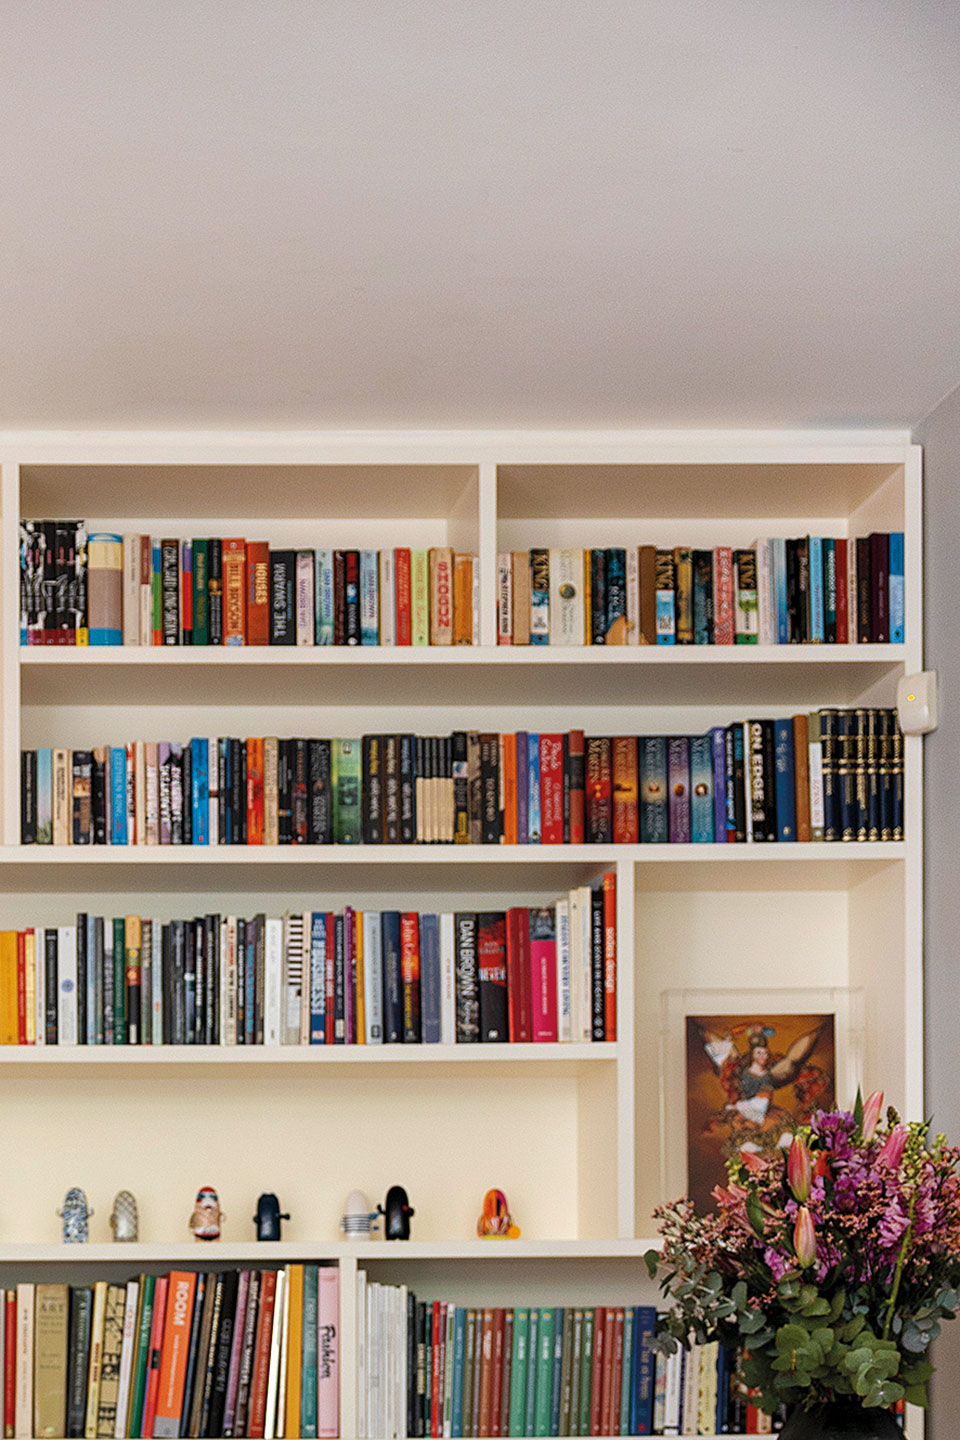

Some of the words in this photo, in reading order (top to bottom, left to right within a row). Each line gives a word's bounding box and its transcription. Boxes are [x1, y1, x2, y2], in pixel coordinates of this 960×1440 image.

[229, 562, 239, 587] BILL
[255, 562, 267, 605] HOUSES
[273, 562, 287, 610] SWARM
[532, 553, 548, 591] KING
[655, 554, 673, 590] KING
[739, 553, 756, 589] KING
[229, 587, 239, 630] BRYSON
[323, 587, 331, 619] BROWN
[438, 561, 449, 628] SHOGUN
[273, 612, 287, 638] THE
[751, 723, 762, 750] ON
[752, 753, 764, 801] EDGE
[460, 920, 474, 948] DAN
[460, 949, 474, 996] BROWN
[604, 960, 614, 993] design
[173, 1280, 189, 1326] ROOM
[320, 1324, 336, 1380] Fashion
[74, 1352, 84, 1405] ARCHITECTURE
